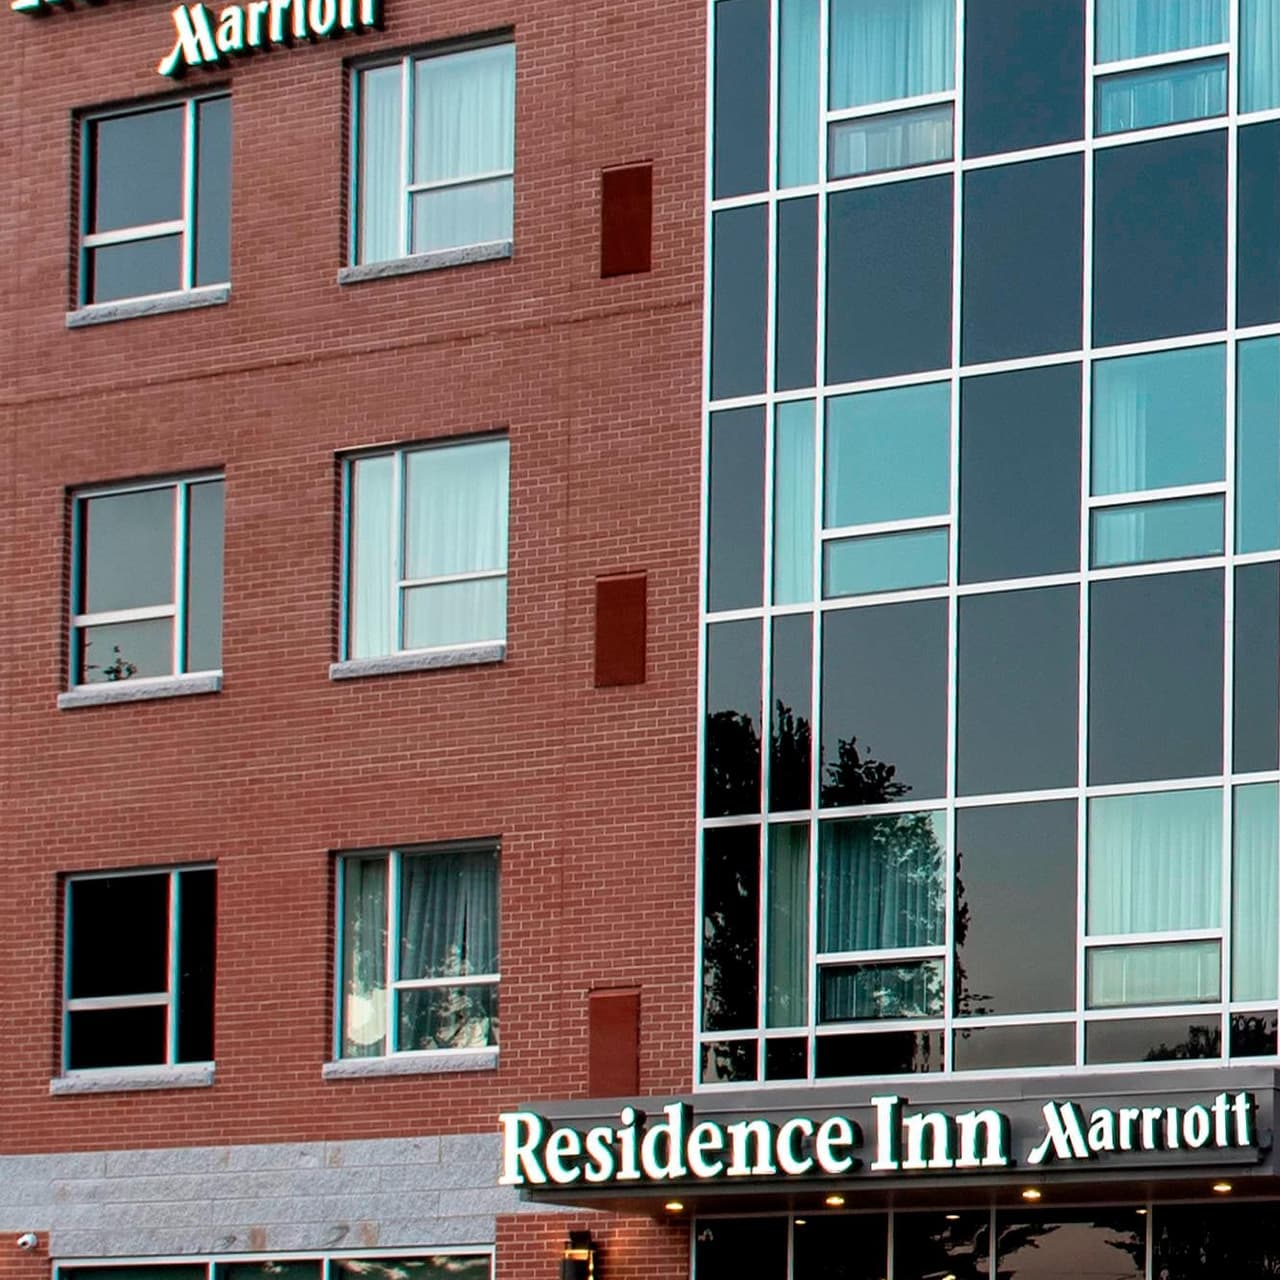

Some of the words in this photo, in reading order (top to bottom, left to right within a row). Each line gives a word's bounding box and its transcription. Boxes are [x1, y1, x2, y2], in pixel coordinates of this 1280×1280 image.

[497, 1102, 855, 1186] Residence
[869, 1094, 1008, 1173] Inn
[1025, 1090, 1253, 1165] Marriott
